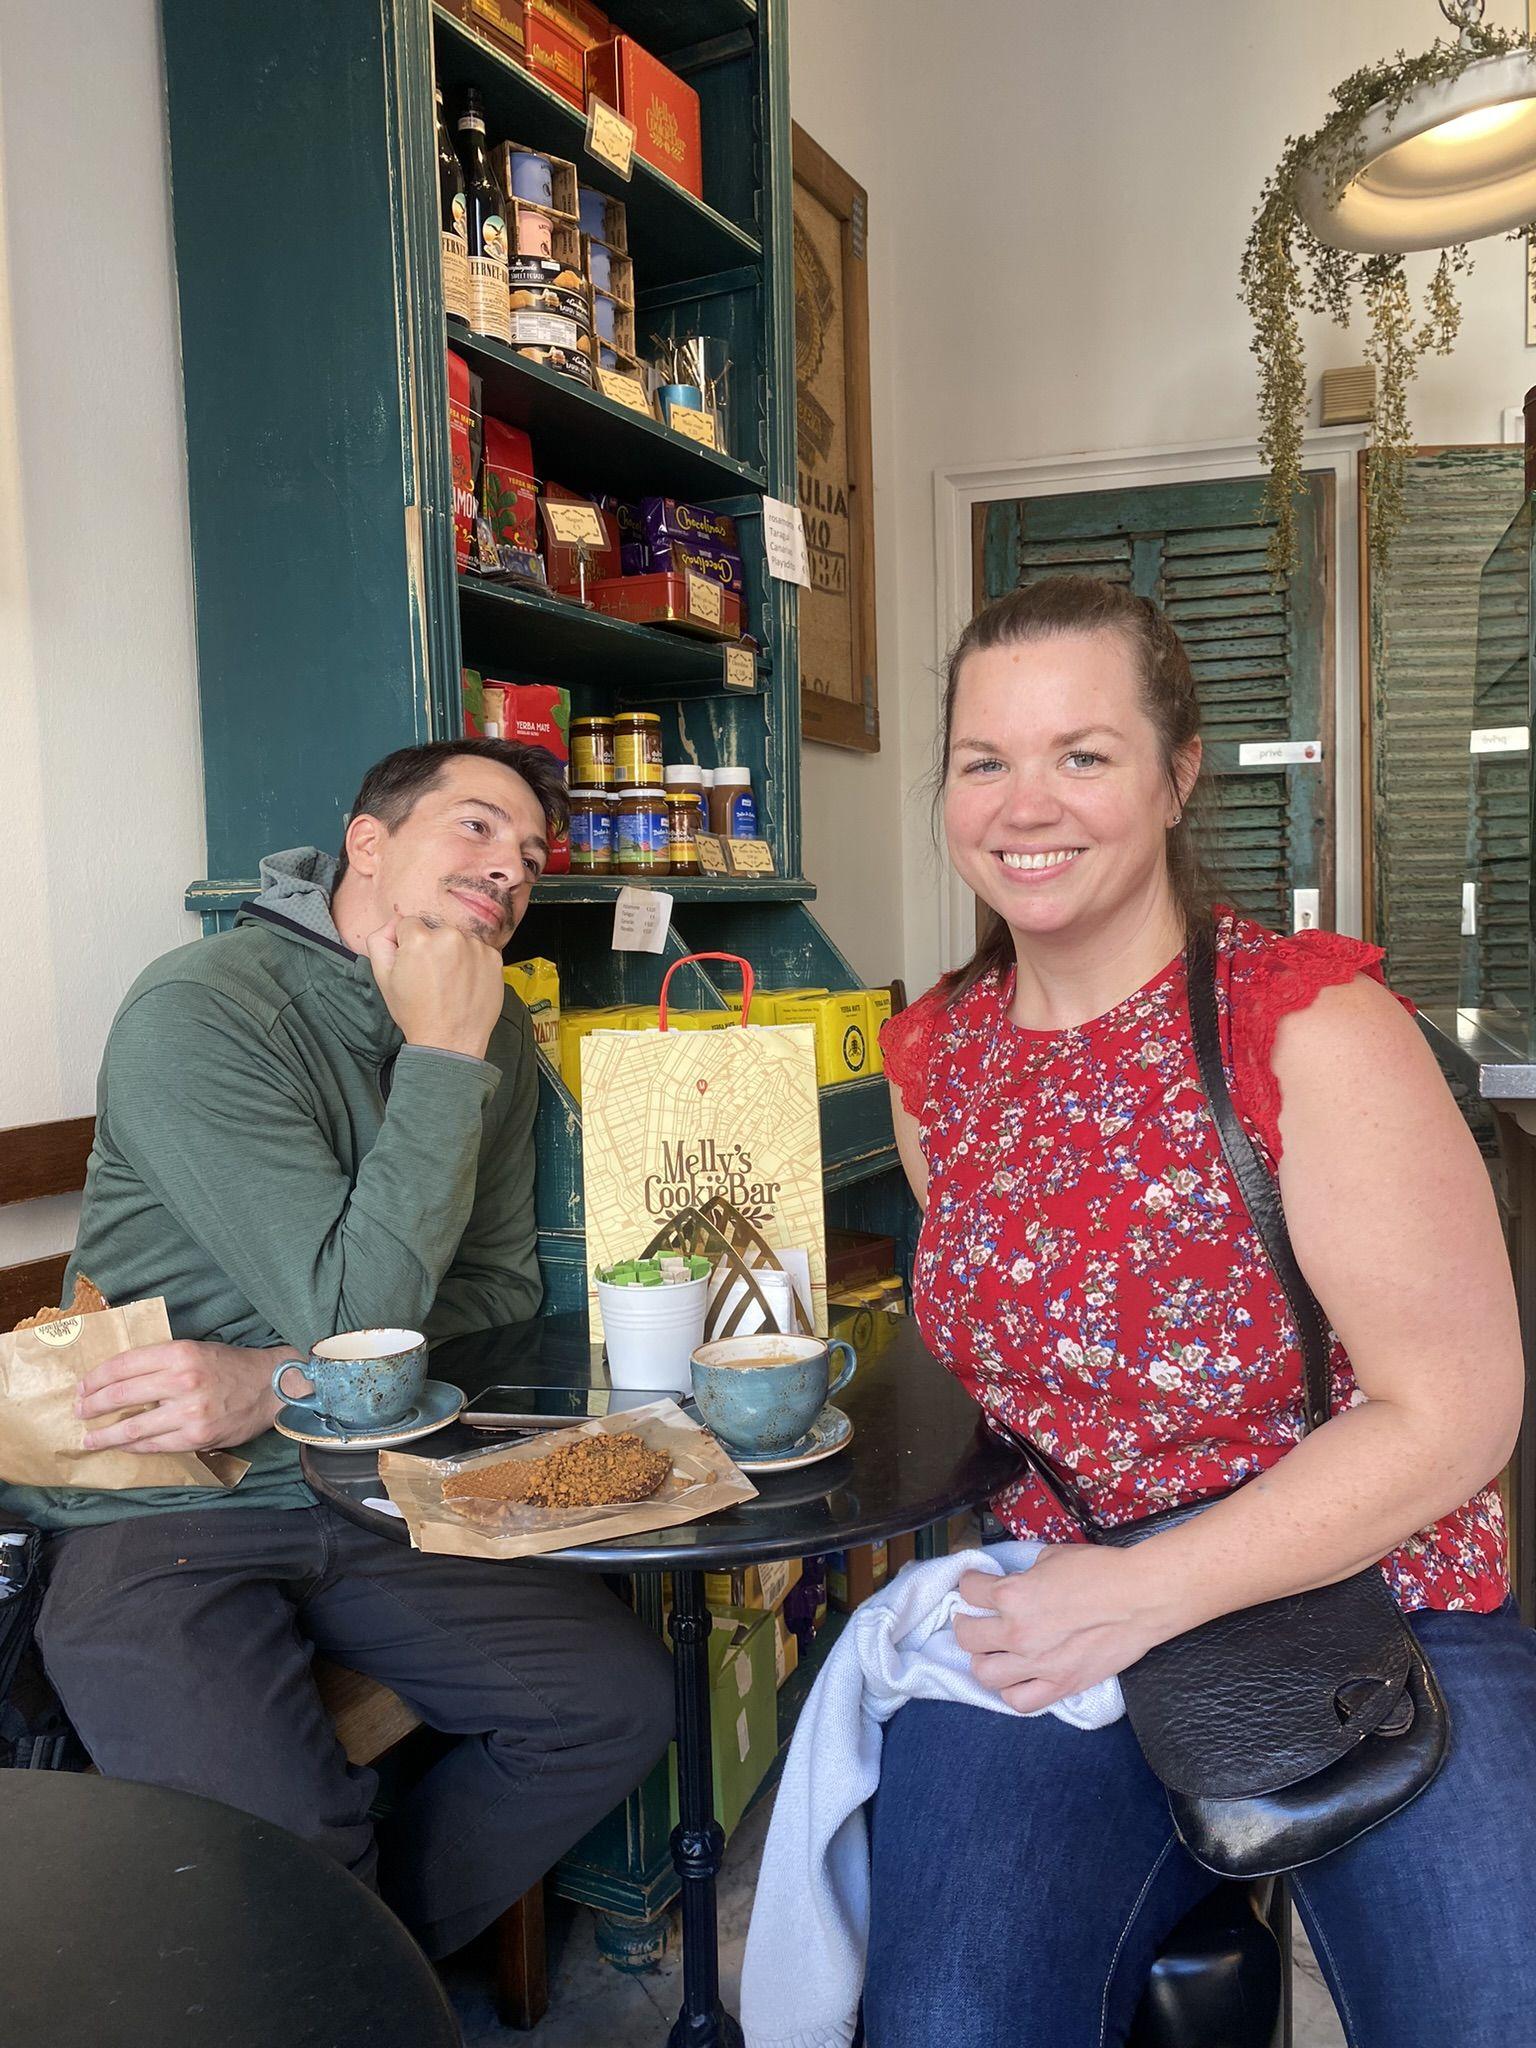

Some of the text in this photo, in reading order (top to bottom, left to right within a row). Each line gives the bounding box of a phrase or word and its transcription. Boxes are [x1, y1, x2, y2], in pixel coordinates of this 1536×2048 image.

[675, 505, 726, 537] Chocolinas
[681, 553, 733, 583] Chocolinas
[516, 721, 550, 733] YERBA MATE
[1259, 748, 1282, 758] privé
[841, 1004, 860, 1013] YERBA MATE
[662, 1138, 752, 1185] Melly's
